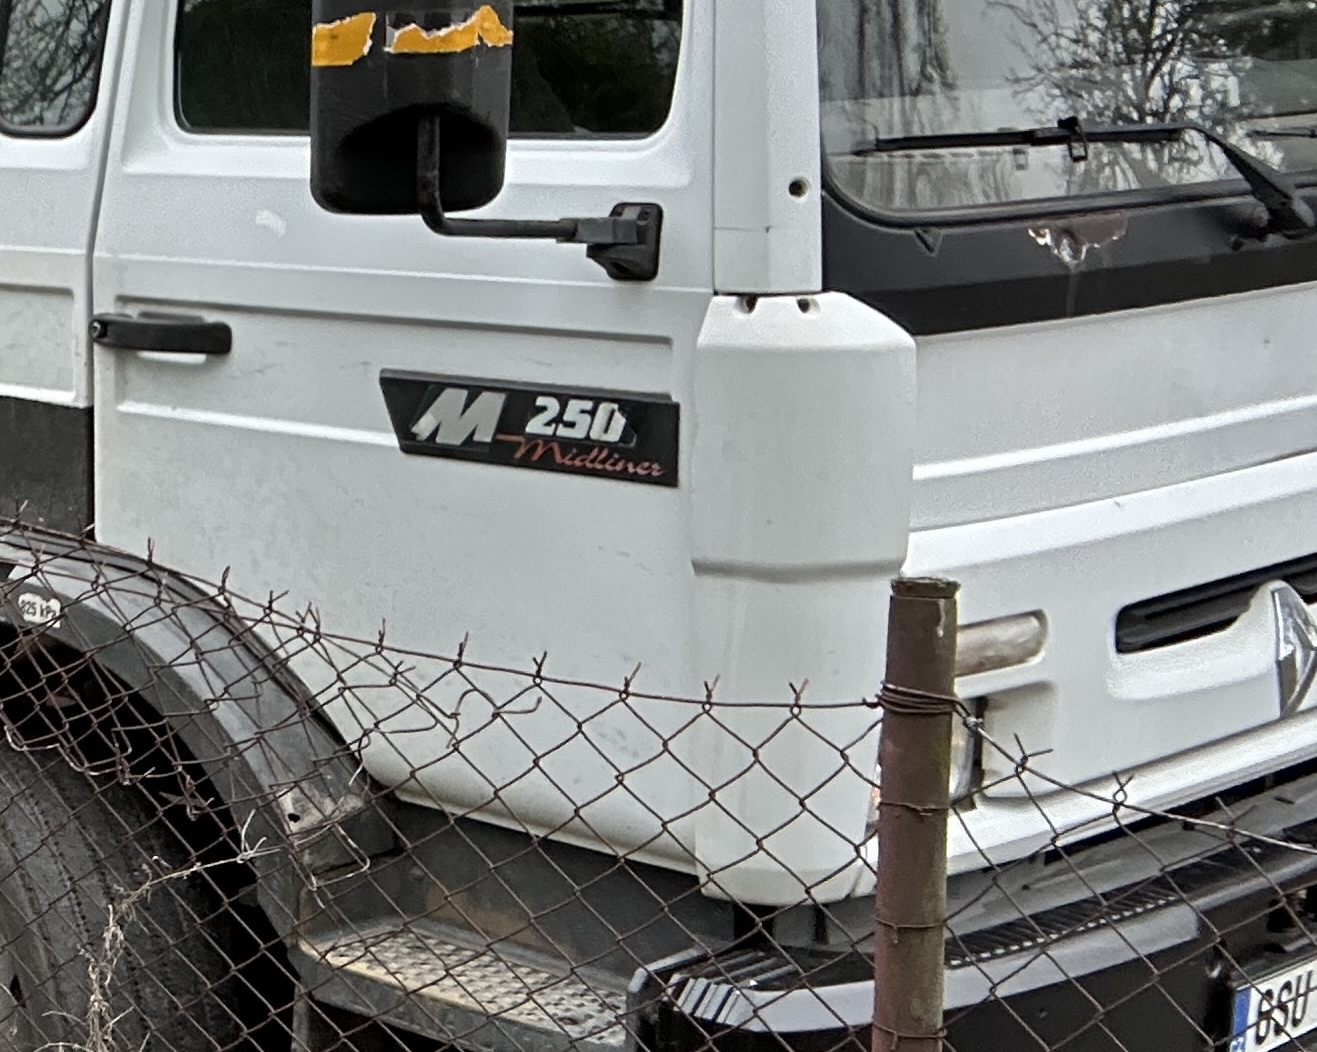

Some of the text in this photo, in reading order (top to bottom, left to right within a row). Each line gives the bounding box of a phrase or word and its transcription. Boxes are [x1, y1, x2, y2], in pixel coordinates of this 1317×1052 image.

[410, 388, 627, 446] M 250
[496, 434, 663, 477] Midliner
